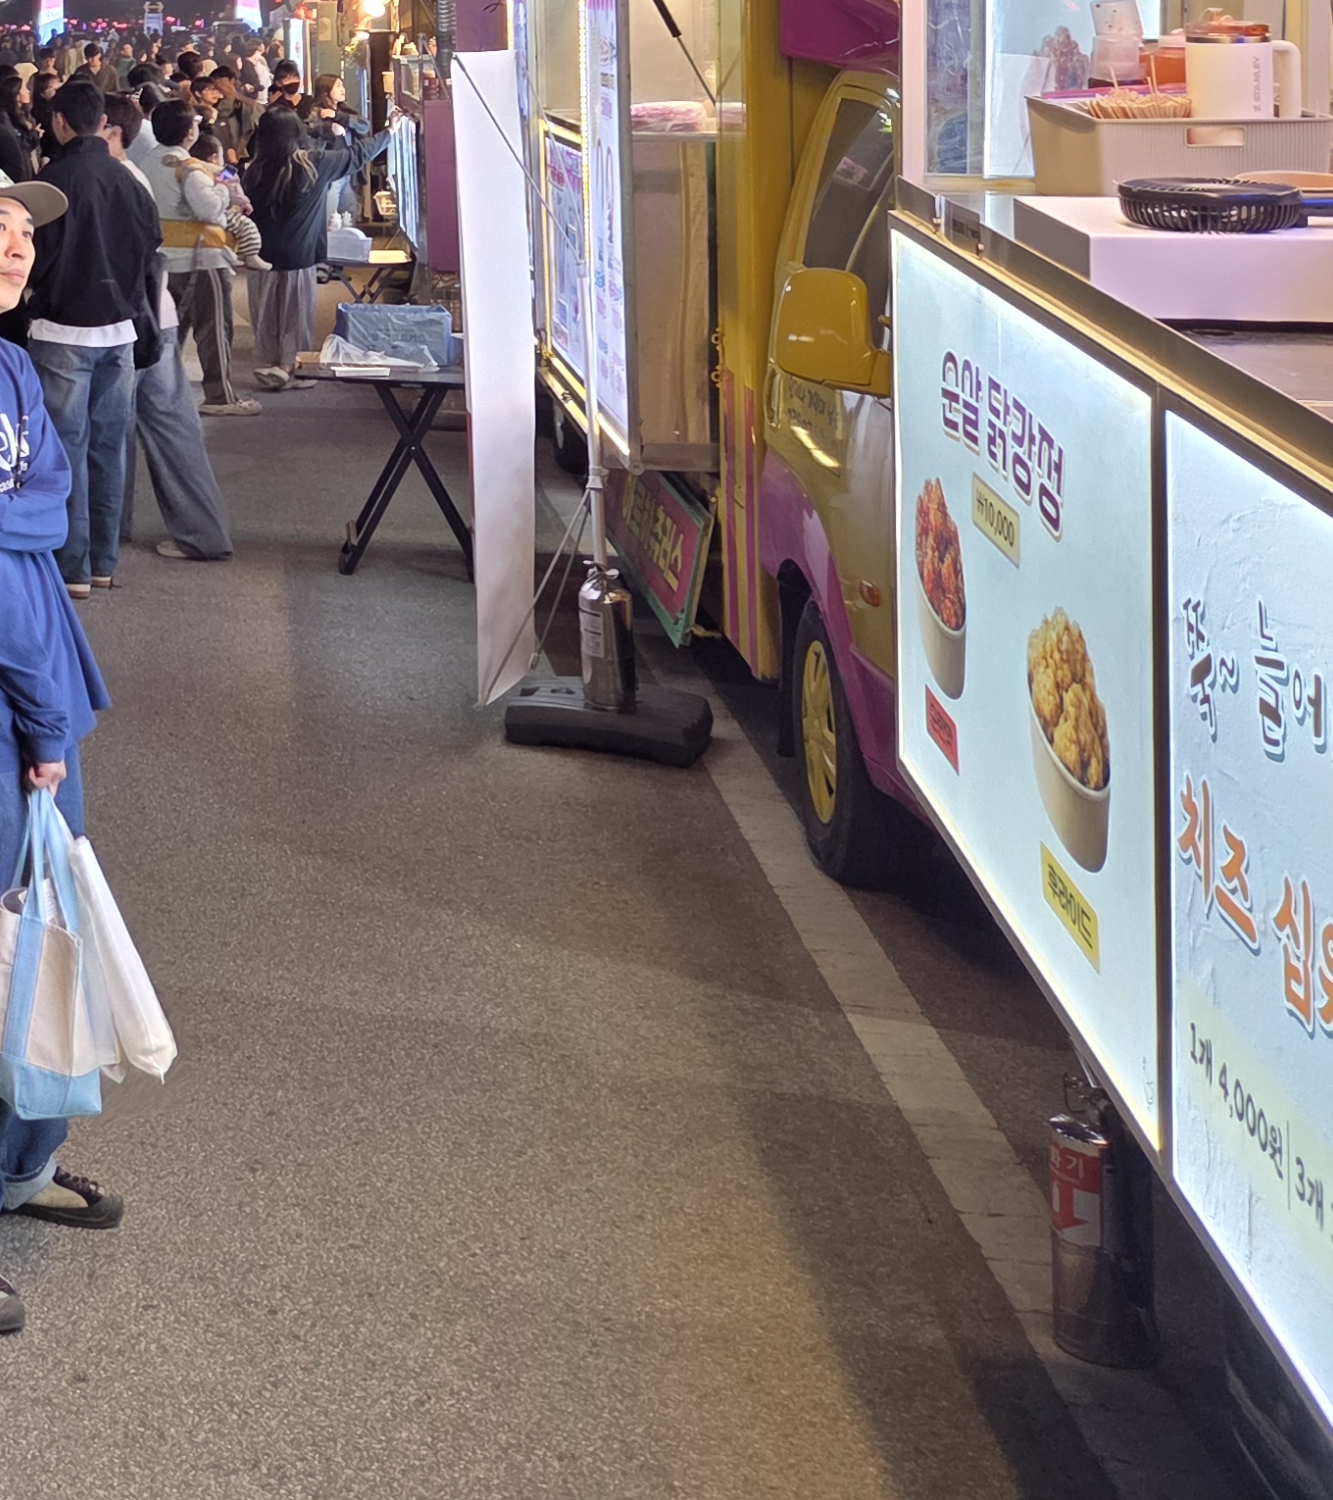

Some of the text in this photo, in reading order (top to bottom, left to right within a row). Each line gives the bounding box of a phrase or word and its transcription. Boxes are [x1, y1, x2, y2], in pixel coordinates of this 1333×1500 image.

[941, 351, 982, 450] 순살
[988, 376, 1065, 534] 닭강정
[1048, 862, 1093, 950] 후라이드
[1178, 774, 1257, 943] 치즈
[1190, 1023, 1325, 1232] 1개 4,000원 3개
